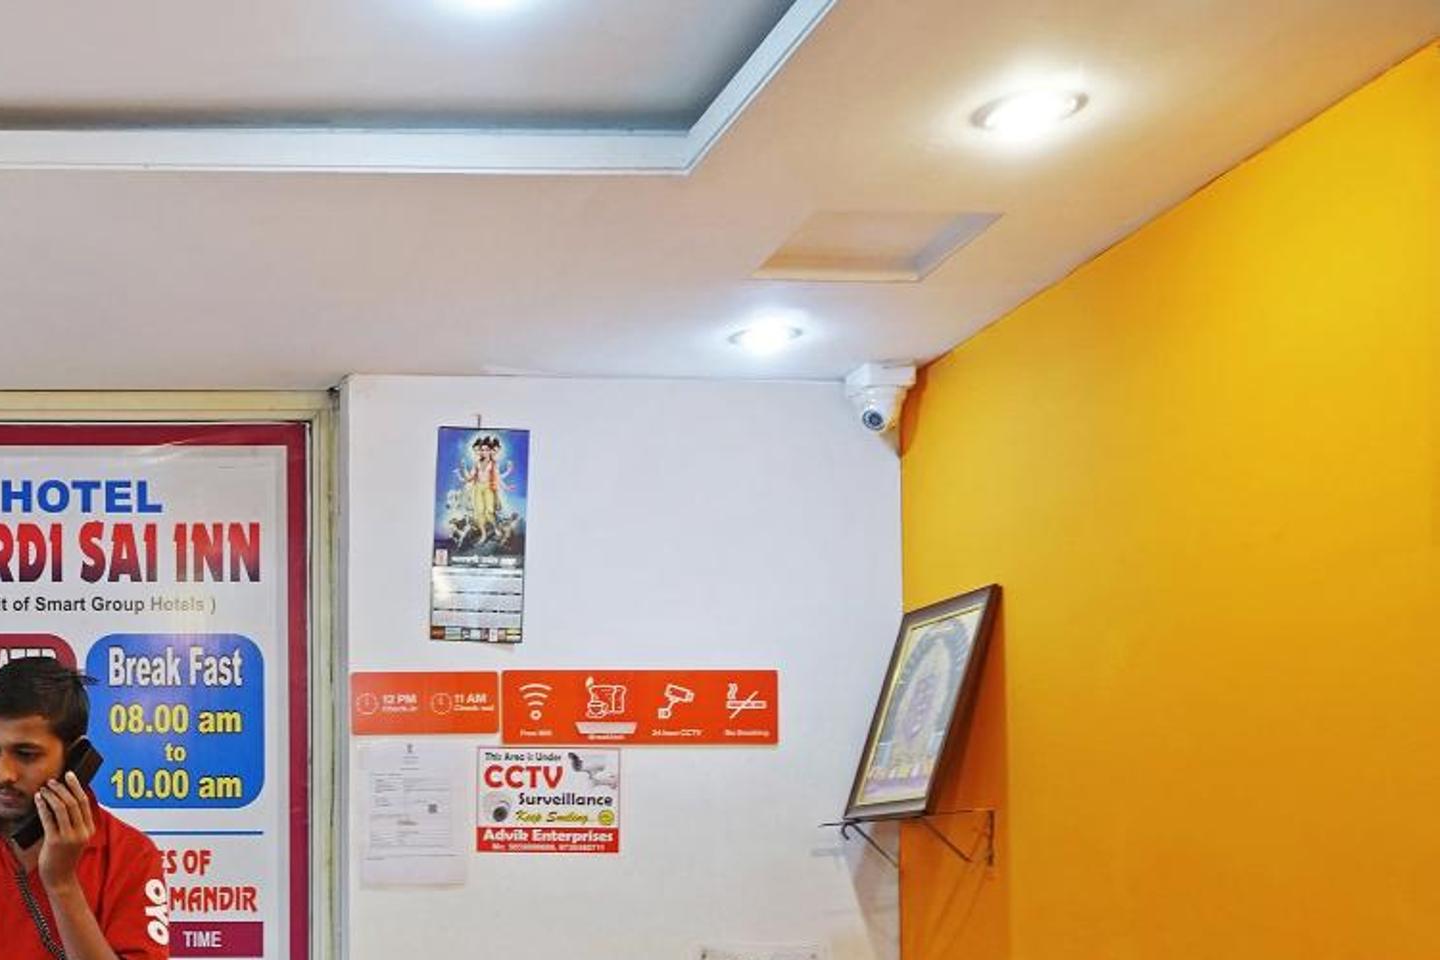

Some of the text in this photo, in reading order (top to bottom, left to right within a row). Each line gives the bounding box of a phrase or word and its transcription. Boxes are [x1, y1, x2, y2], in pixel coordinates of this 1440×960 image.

[1, 480, 162, 513] HOTEL
[78, 521, 158, 583] SAI
[173, 522, 260, 583] INN
[12, 596, 30, 611] of
[35, 596, 85, 612] Smart
[91, 597, 145, 615] Group
[150, 597, 205, 611] Hotels
[108, 646, 243, 687] Break Fast
[397, 693, 418, 704] PM
[466, 693, 487, 704] AM
[109, 704, 242, 733] 08.00 am
[164, 743, 187, 762] to
[485, 752, 502, 761] This
[505, 752, 525, 761] Area
[535, 752, 562, 761] Under
[110, 770, 242, 799] 10.00 am
[483, 764, 564, 789] CCTV
[517, 793, 614, 806] Surveillance
[532, 829, 614, 843] Enterprises
[182, 850, 212, 876] OF
[145, 878, 170, 946] OYO
[170, 886, 258, 913] MANDIR
[182, 930, 222, 948] TIME
